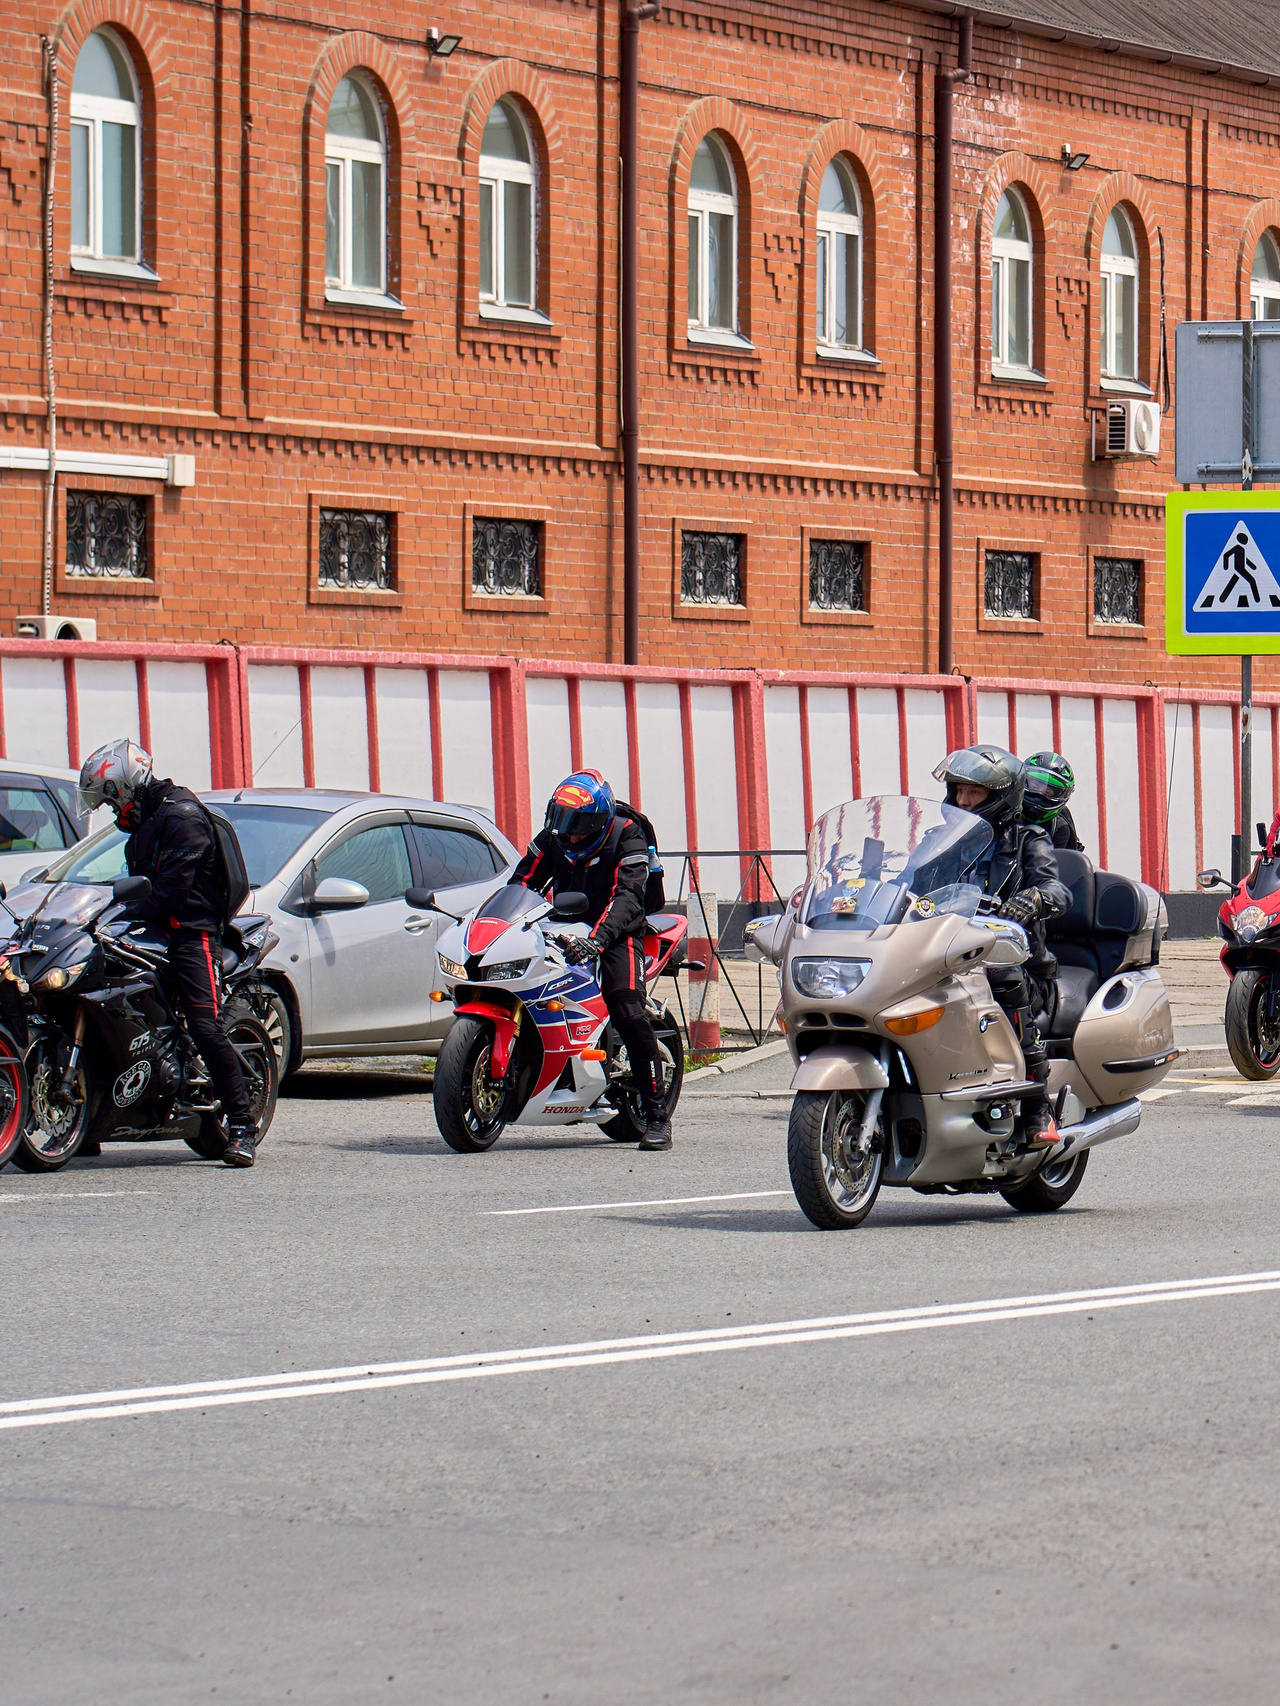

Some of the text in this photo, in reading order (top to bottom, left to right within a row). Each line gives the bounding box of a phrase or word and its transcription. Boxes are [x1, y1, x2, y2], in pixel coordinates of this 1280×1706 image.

[249, 932, 265, 946] 675
[128, 1030, 151, 1052] 675
[541, 1105, 586, 1114] HONDA
[110, 1123, 184, 1140] Daytona
